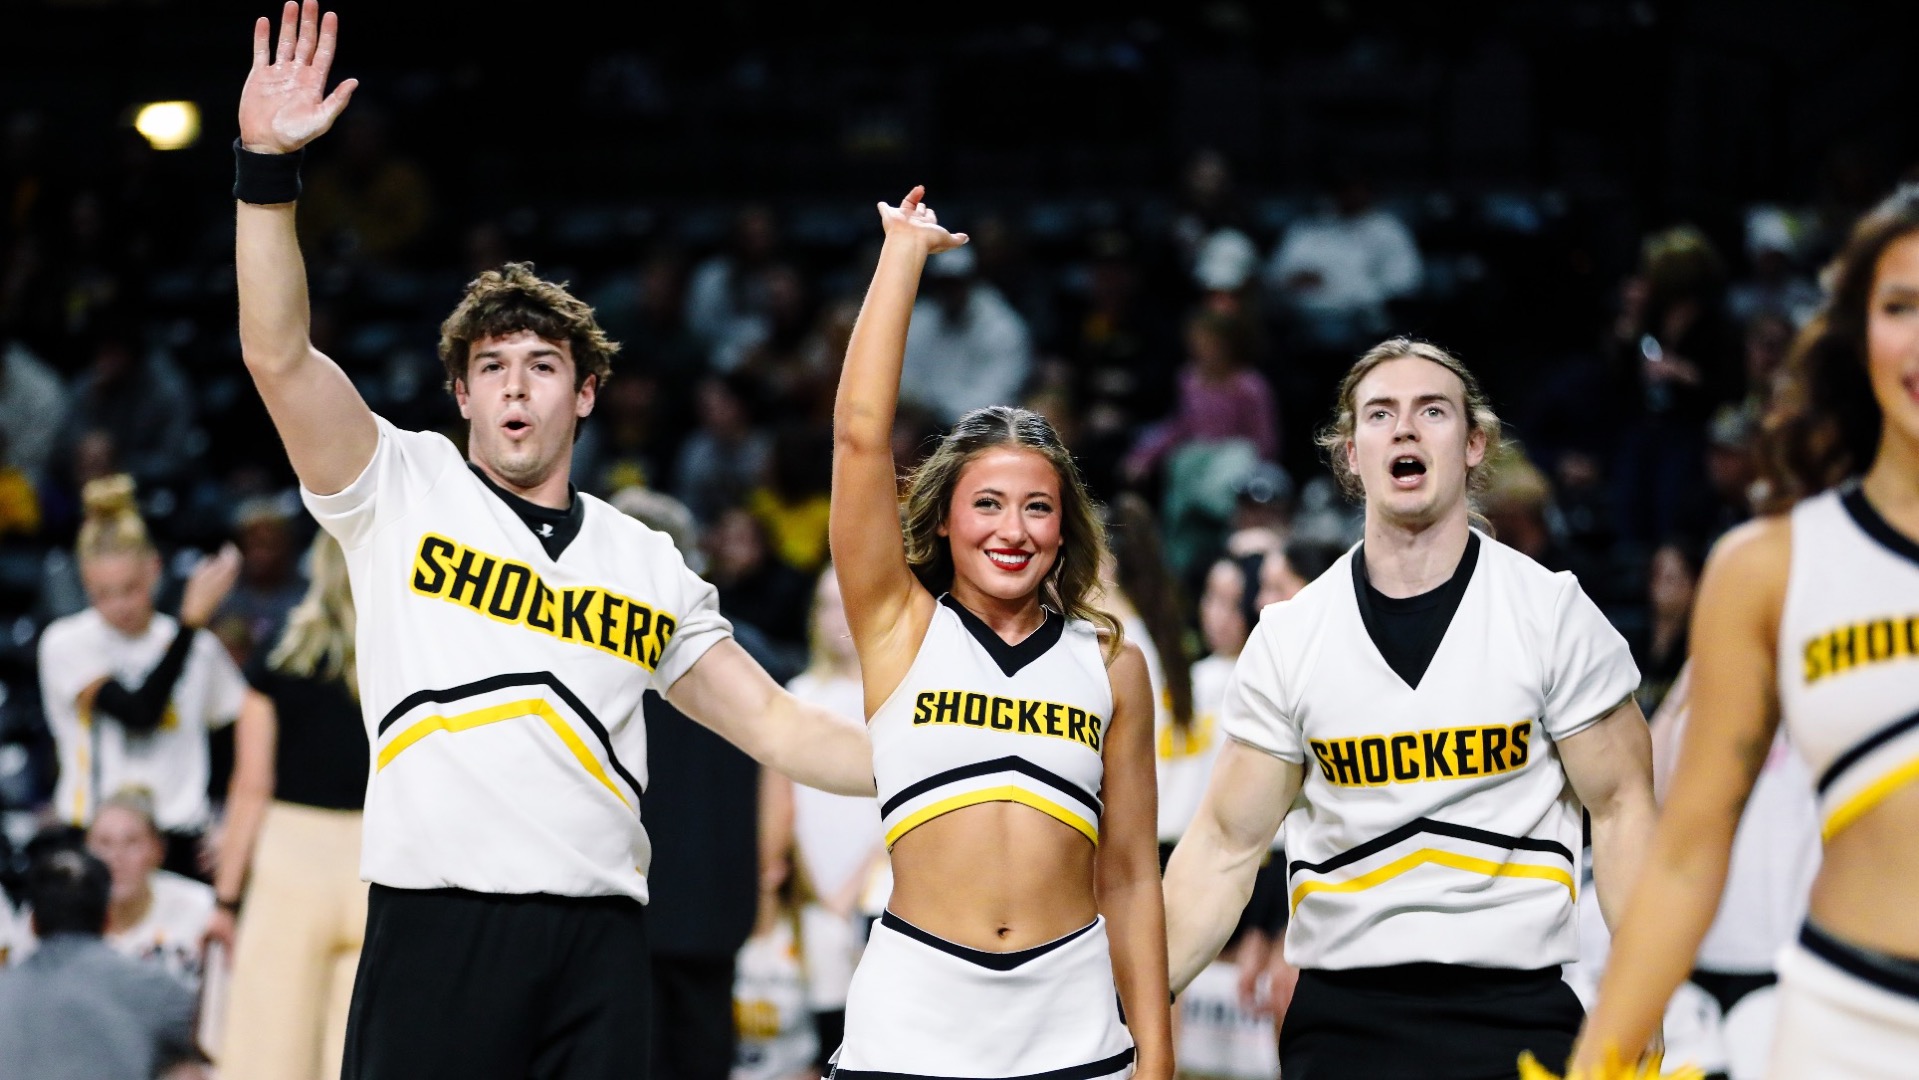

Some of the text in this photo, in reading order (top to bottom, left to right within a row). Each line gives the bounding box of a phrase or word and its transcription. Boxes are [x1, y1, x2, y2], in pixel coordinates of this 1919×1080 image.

[413, 535, 676, 669] SHOCKERS
[913, 691, 1101, 752] SHOCKERS
[1310, 723, 1531, 784] SHOCKERS
